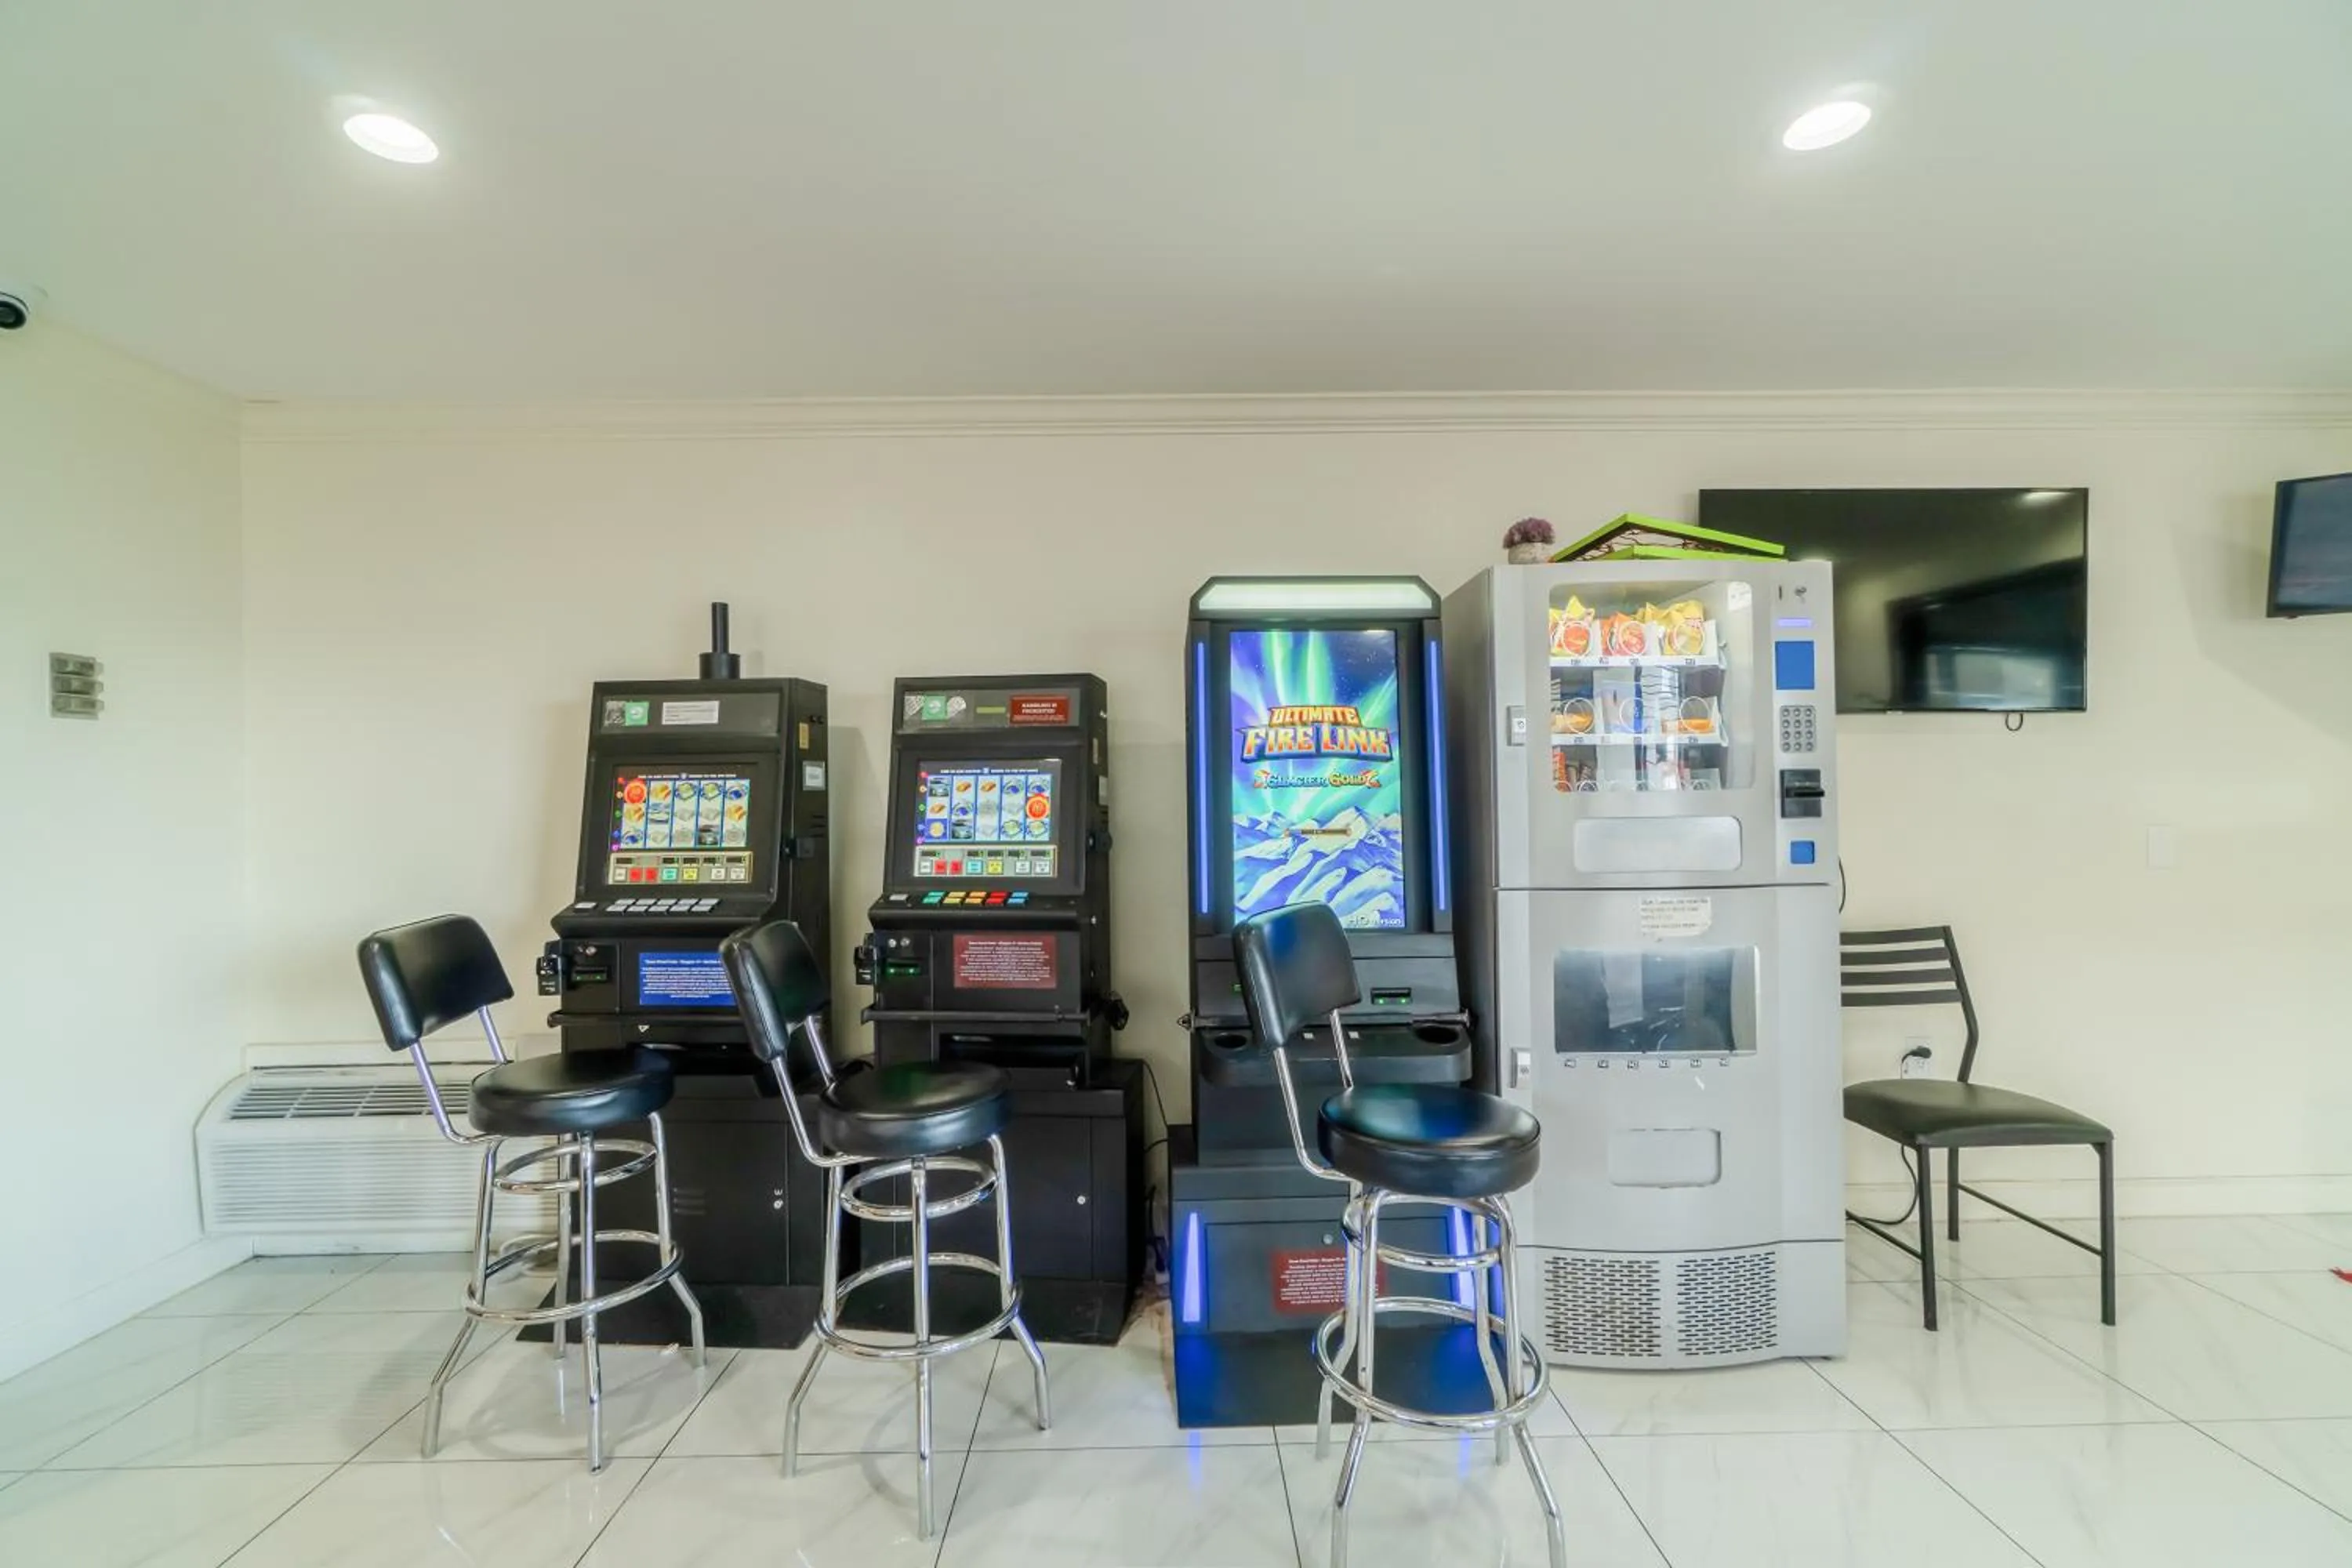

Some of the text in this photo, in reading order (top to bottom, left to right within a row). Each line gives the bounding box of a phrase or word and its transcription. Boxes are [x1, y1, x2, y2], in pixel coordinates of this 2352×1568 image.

[1271, 706, 1357, 724] ULTIMATE
[1243, 724, 1390, 757] FIRE LINK
